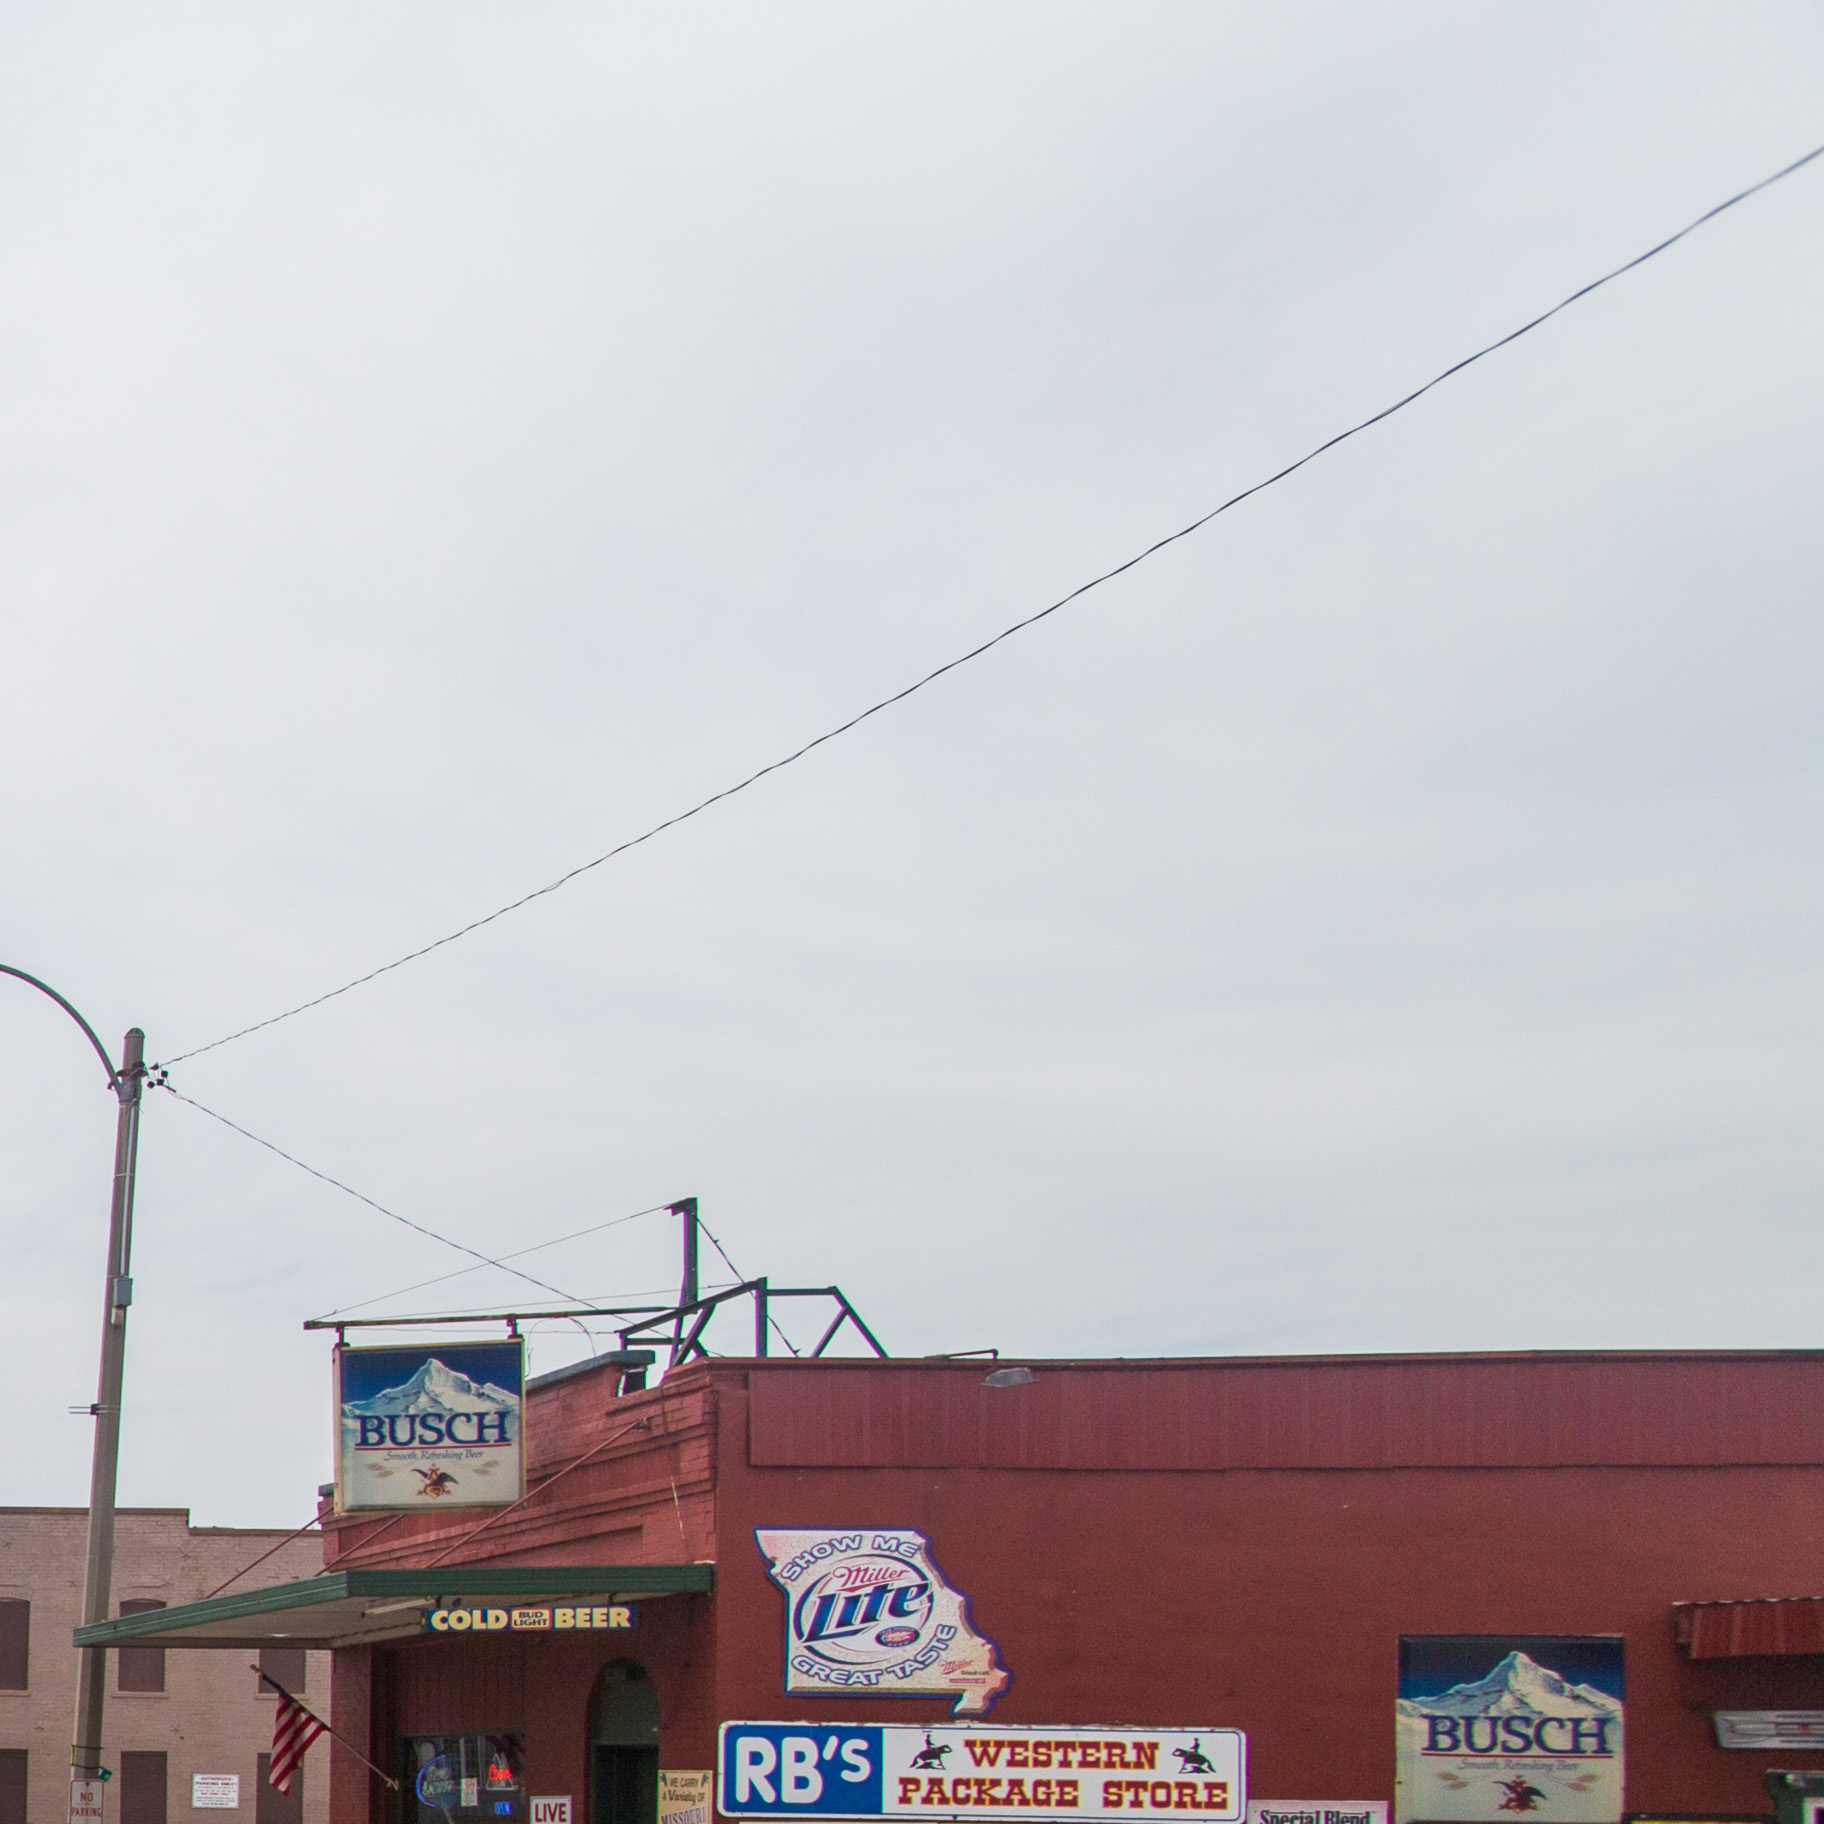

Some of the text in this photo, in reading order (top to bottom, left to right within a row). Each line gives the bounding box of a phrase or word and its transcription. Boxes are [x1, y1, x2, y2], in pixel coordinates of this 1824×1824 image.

[354, 1411, 512, 1447] BUSCH
[465, 1450, 483, 1459] Beer
[781, 1535, 921, 1582] SHOW ME
[832, 1565, 909, 1590] Miller
[431, 1609, 509, 1631] COLD
[513, 1618, 548, 1627] LIGHT
[518, 1611, 544, 1619] BUD
[554, 1607, 631, 1629] BEER
[801, 1581, 933, 1643] Lite
[791, 1654, 882, 1686] GREAT
[886, 1624, 957, 1679] TASTE
[1419, 1714, 1613, 1754] BUSCH
[963, 1739, 1160, 1770] WESTERN
[735, 1735, 872, 1804] RB'S
[669, 1777, 678, 1787] WE
[80, 1792, 94, 1802] NO
[668, 1789, 696, 1806] Variety
[898, 1777, 1229, 1810] PACKAGE STORE
[72, 1807, 101, 1817] PARKING
[534, 1803, 567, 1823] LIVE
